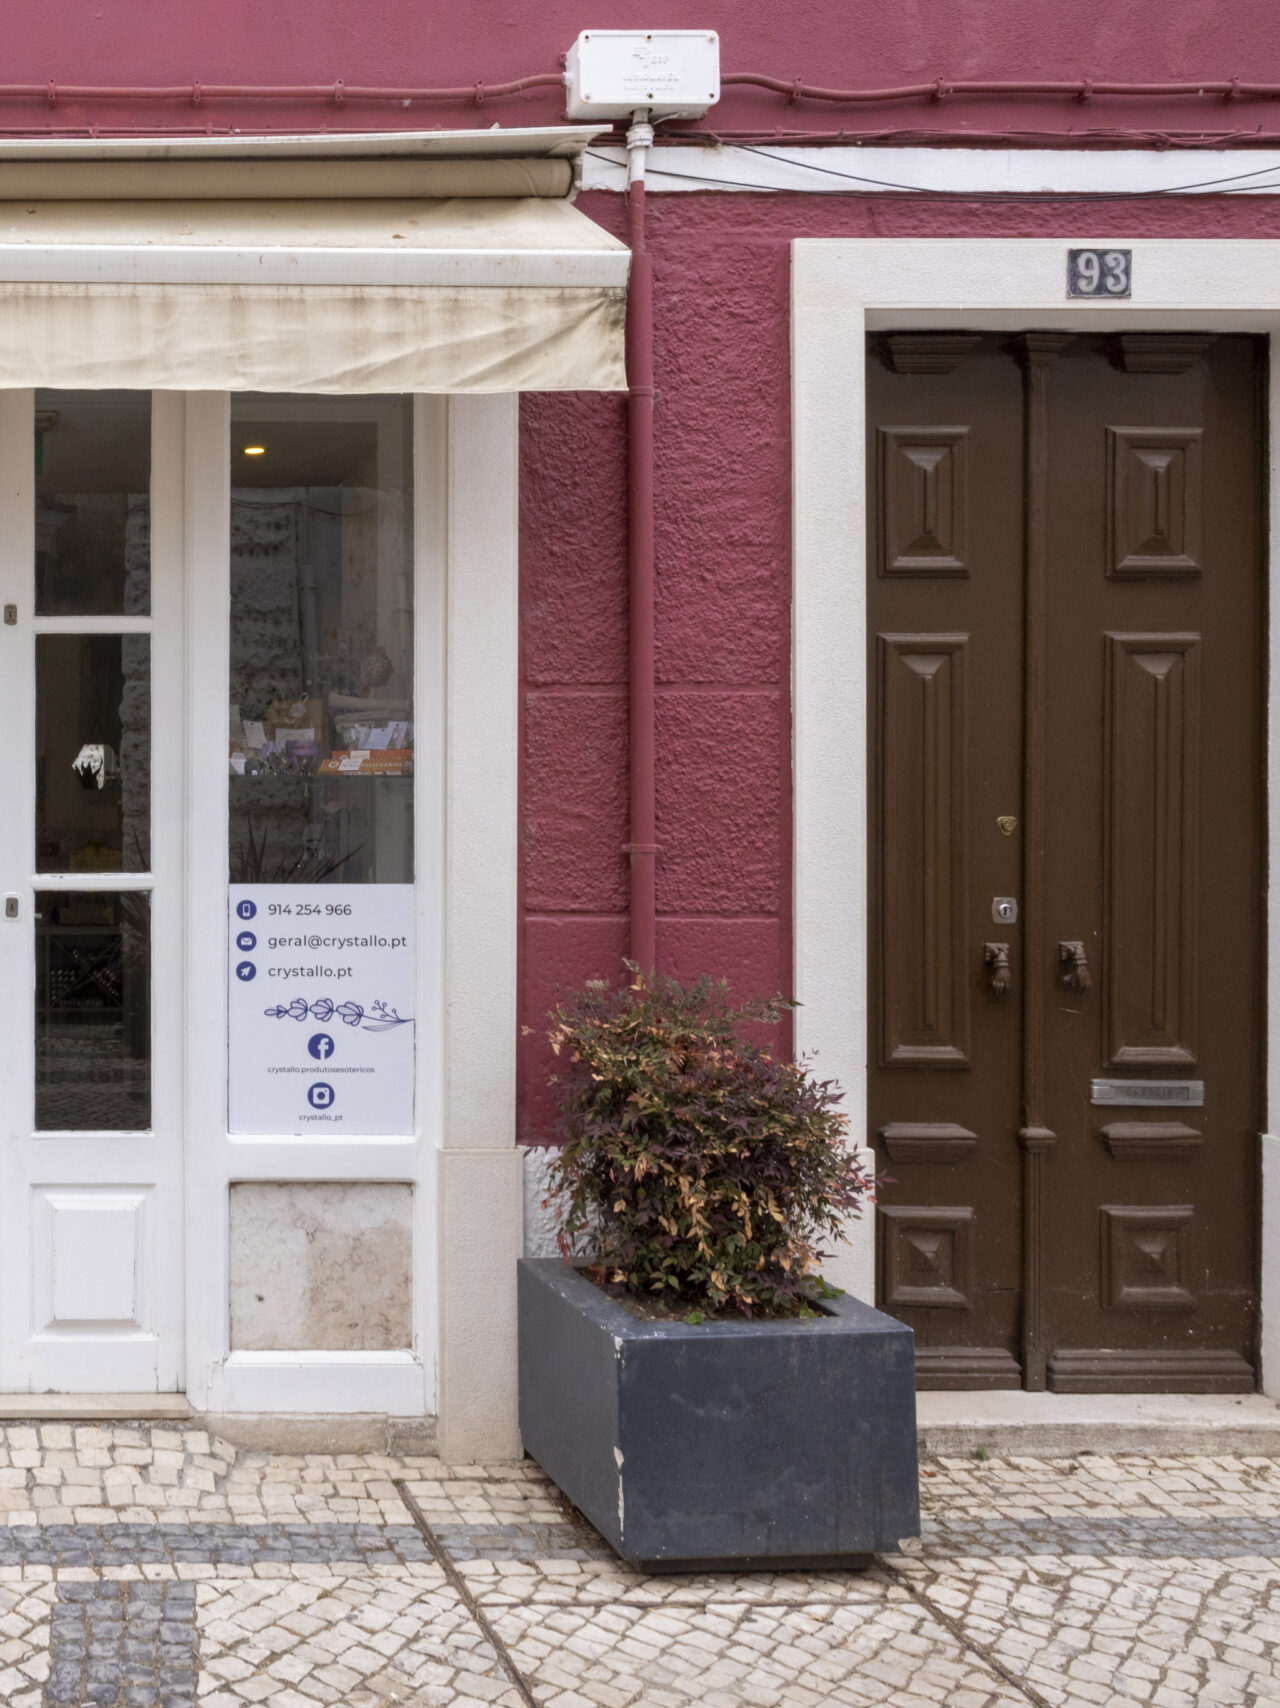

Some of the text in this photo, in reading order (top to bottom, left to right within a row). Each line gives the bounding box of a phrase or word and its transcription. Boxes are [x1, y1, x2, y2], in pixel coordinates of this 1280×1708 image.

[1077, 251, 1128, 293] 93
[268, 904, 352, 916] 914 254 966
[268, 935, 407, 950] geral@crystallo.pt
[268, 965, 353, 980] crystallo.pt
